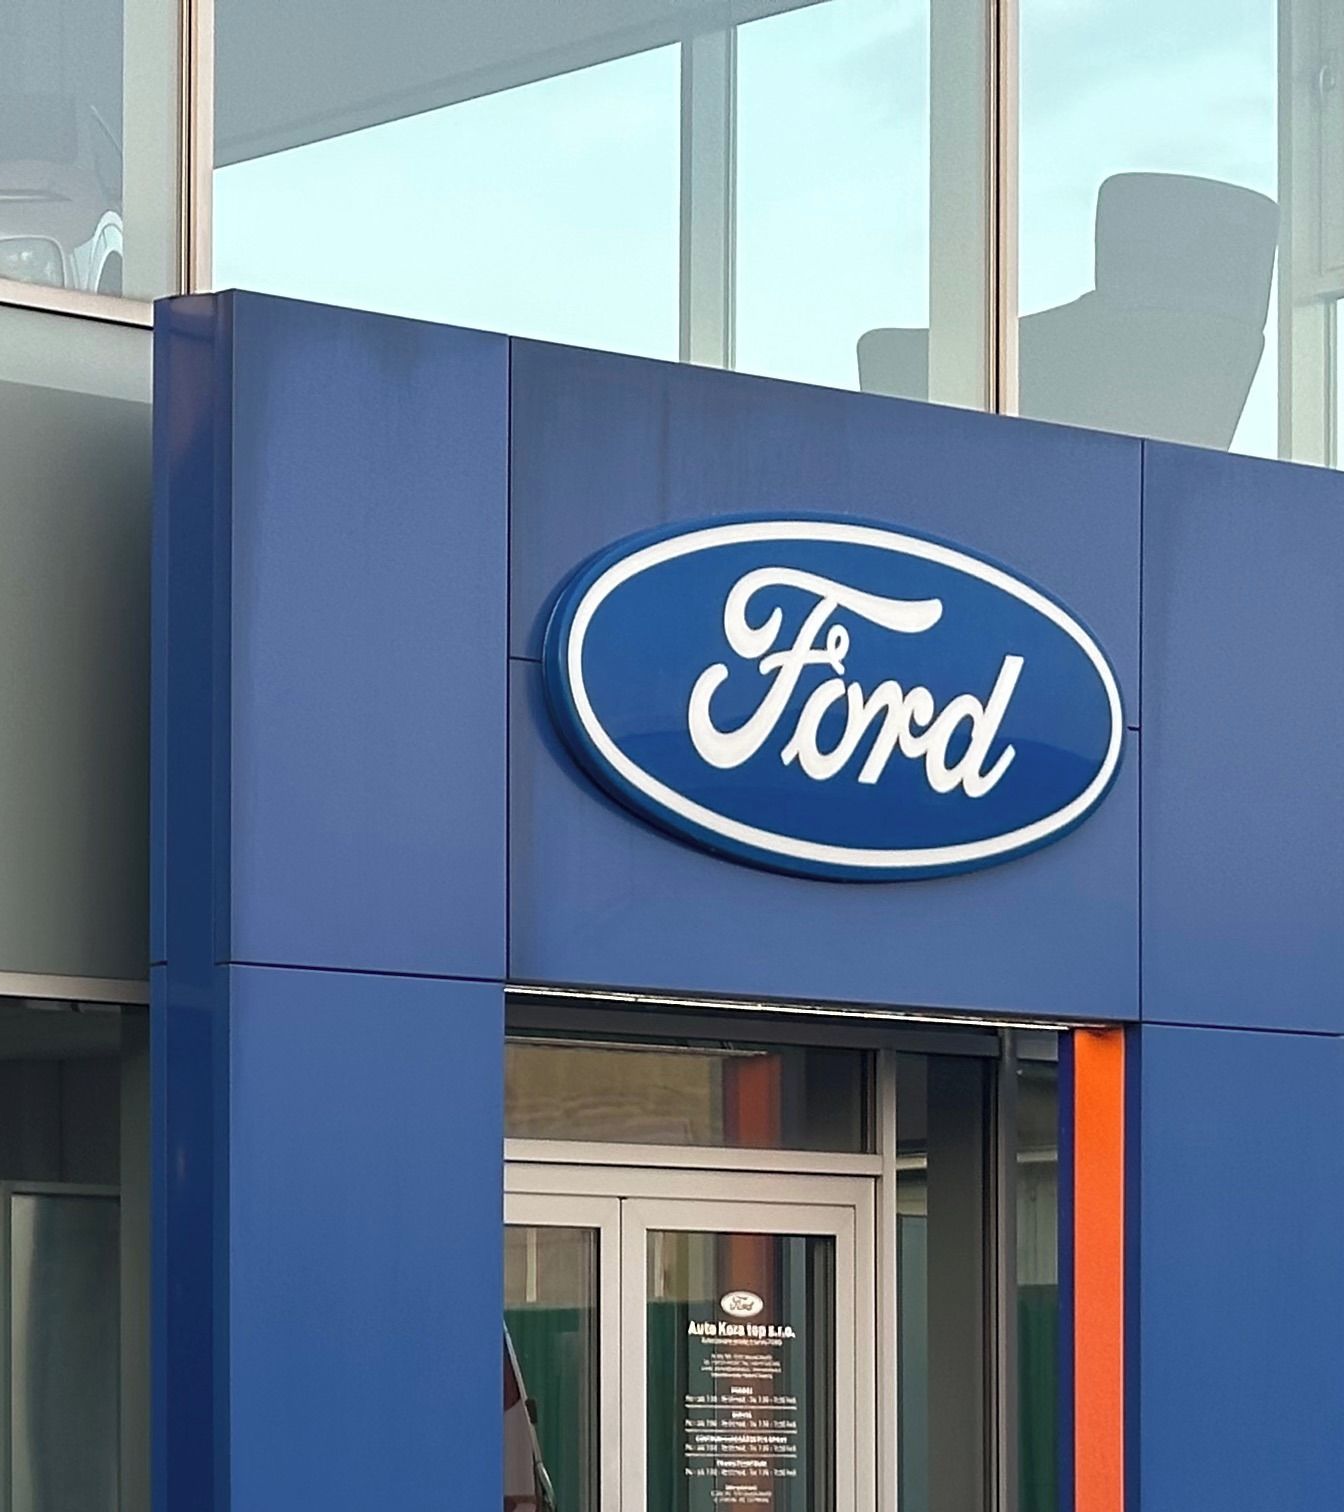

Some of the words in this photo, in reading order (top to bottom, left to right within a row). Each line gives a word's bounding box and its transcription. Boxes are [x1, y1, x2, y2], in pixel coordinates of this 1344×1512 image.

[688, 566, 1025, 798] Ford
[688, 1320, 717, 1336] Auto
[718, 1321, 745, 1337] Kora
[746, 1322, 767, 1340] top
[768, 1325, 796, 1339] s.r.o.
